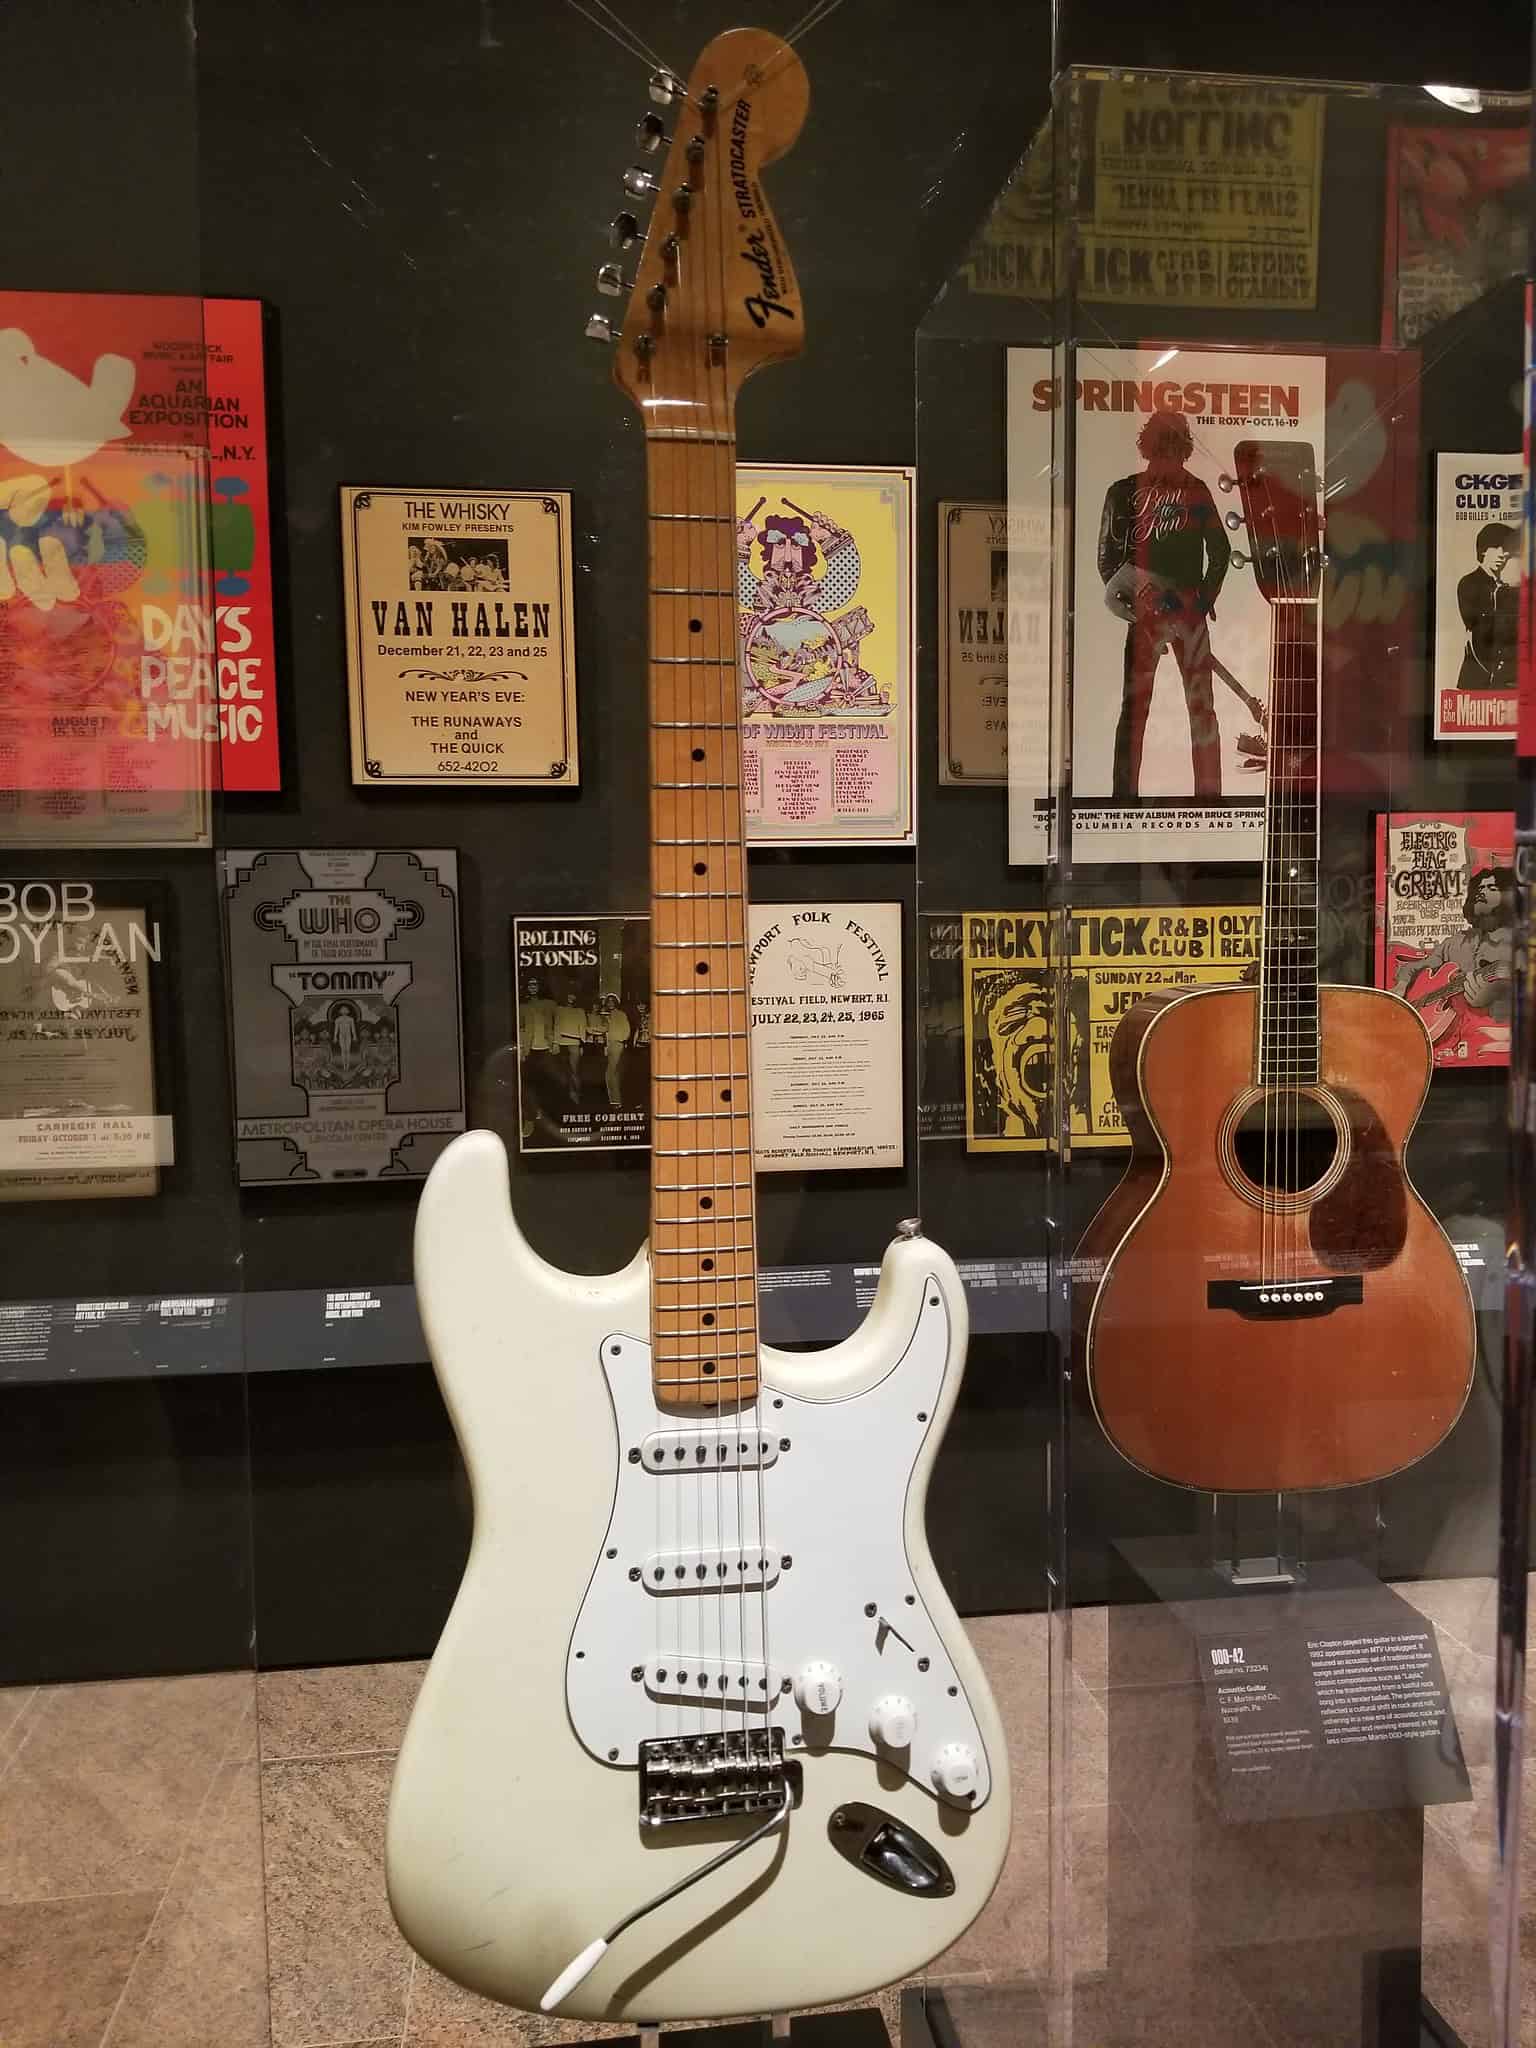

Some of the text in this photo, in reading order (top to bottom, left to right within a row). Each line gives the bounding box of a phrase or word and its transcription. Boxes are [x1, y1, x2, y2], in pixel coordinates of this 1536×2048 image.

[729, 97, 757, 219] STRATOCASTER
[739, 227, 795, 328] Fender
[175, 378, 203, 393] AN
[138, 393, 240, 412] AQUARIAN
[128, 409, 249, 429] EXPOSITION
[1196, 416, 1216, 425] THE
[1455, 494, 1501, 509] CLUB
[404, 501, 511, 521] THE WHISKY
[401, 523, 515, 533] KIM FOWLEY PRESENTS
[371, 600, 550, 638] VAN HALEN
[141, 604, 252, 653] DAYS
[377, 644, 548, 659] December 21, 22, 23 and 25
[139, 656, 264, 700] PEACE
[405, 690, 526, 703] NEW YEAR'S EVE:
[146, 702, 264, 744] MUSIC
[410, 716, 523, 728] THE RUNAWAYS
[454, 729, 478, 740] and
[818, 723, 889, 740] FESTIVAL
[431, 742, 505, 754] THE QUICK
[437, 760, 498, 772] 652-4202
[1104, 812, 1121, 820] THE
[1123, 812, 1145, 820] NEW
[1146, 811, 1176, 820] ALBUM
[1178, 811, 1203, 819] FROM
[1205, 811, 1233, 819] BRUCE
[1142, 821, 1201, 829] RECORDS
[1208, 821, 1233, 829] AND
[1399, 831, 1457, 851] ELECTRIC
[1411, 850, 1448, 870] FLAG
[1394, 869, 1465, 901] CREAM
[0, 883, 95, 922] BOB
[299, 907, 381, 935] WHO
[0, 923, 162, 963] DYLAN
[519, 929, 597, 947] ROLLING
[969, 918, 1054, 960] RICKY
[1070, 917, 1152, 957] TICK
[748, 923, 783, 985] NEWPORT
[792, 911, 833, 927] FOLK
[845, 919, 889, 982] FESTIVAL
[1149, 937, 1204, 958] CLUB
[519, 949, 598, 967] STONES
[1095, 972, 1142, 985] SUNDAY
[751, 1012, 782, 1028] JULY
[859, 1010, 885, 1022] 1965
[36, 1120, 135, 1132] CARNEGIE HALL
[240, 1116, 454, 1136] METROPOLITAN OPERA HOUSE
[562, 1112, 645, 1124] FREE CONCERT
[17, 1135, 49, 1144] FRIDAY
[1211, 1647, 1246, 1666] 000-42
